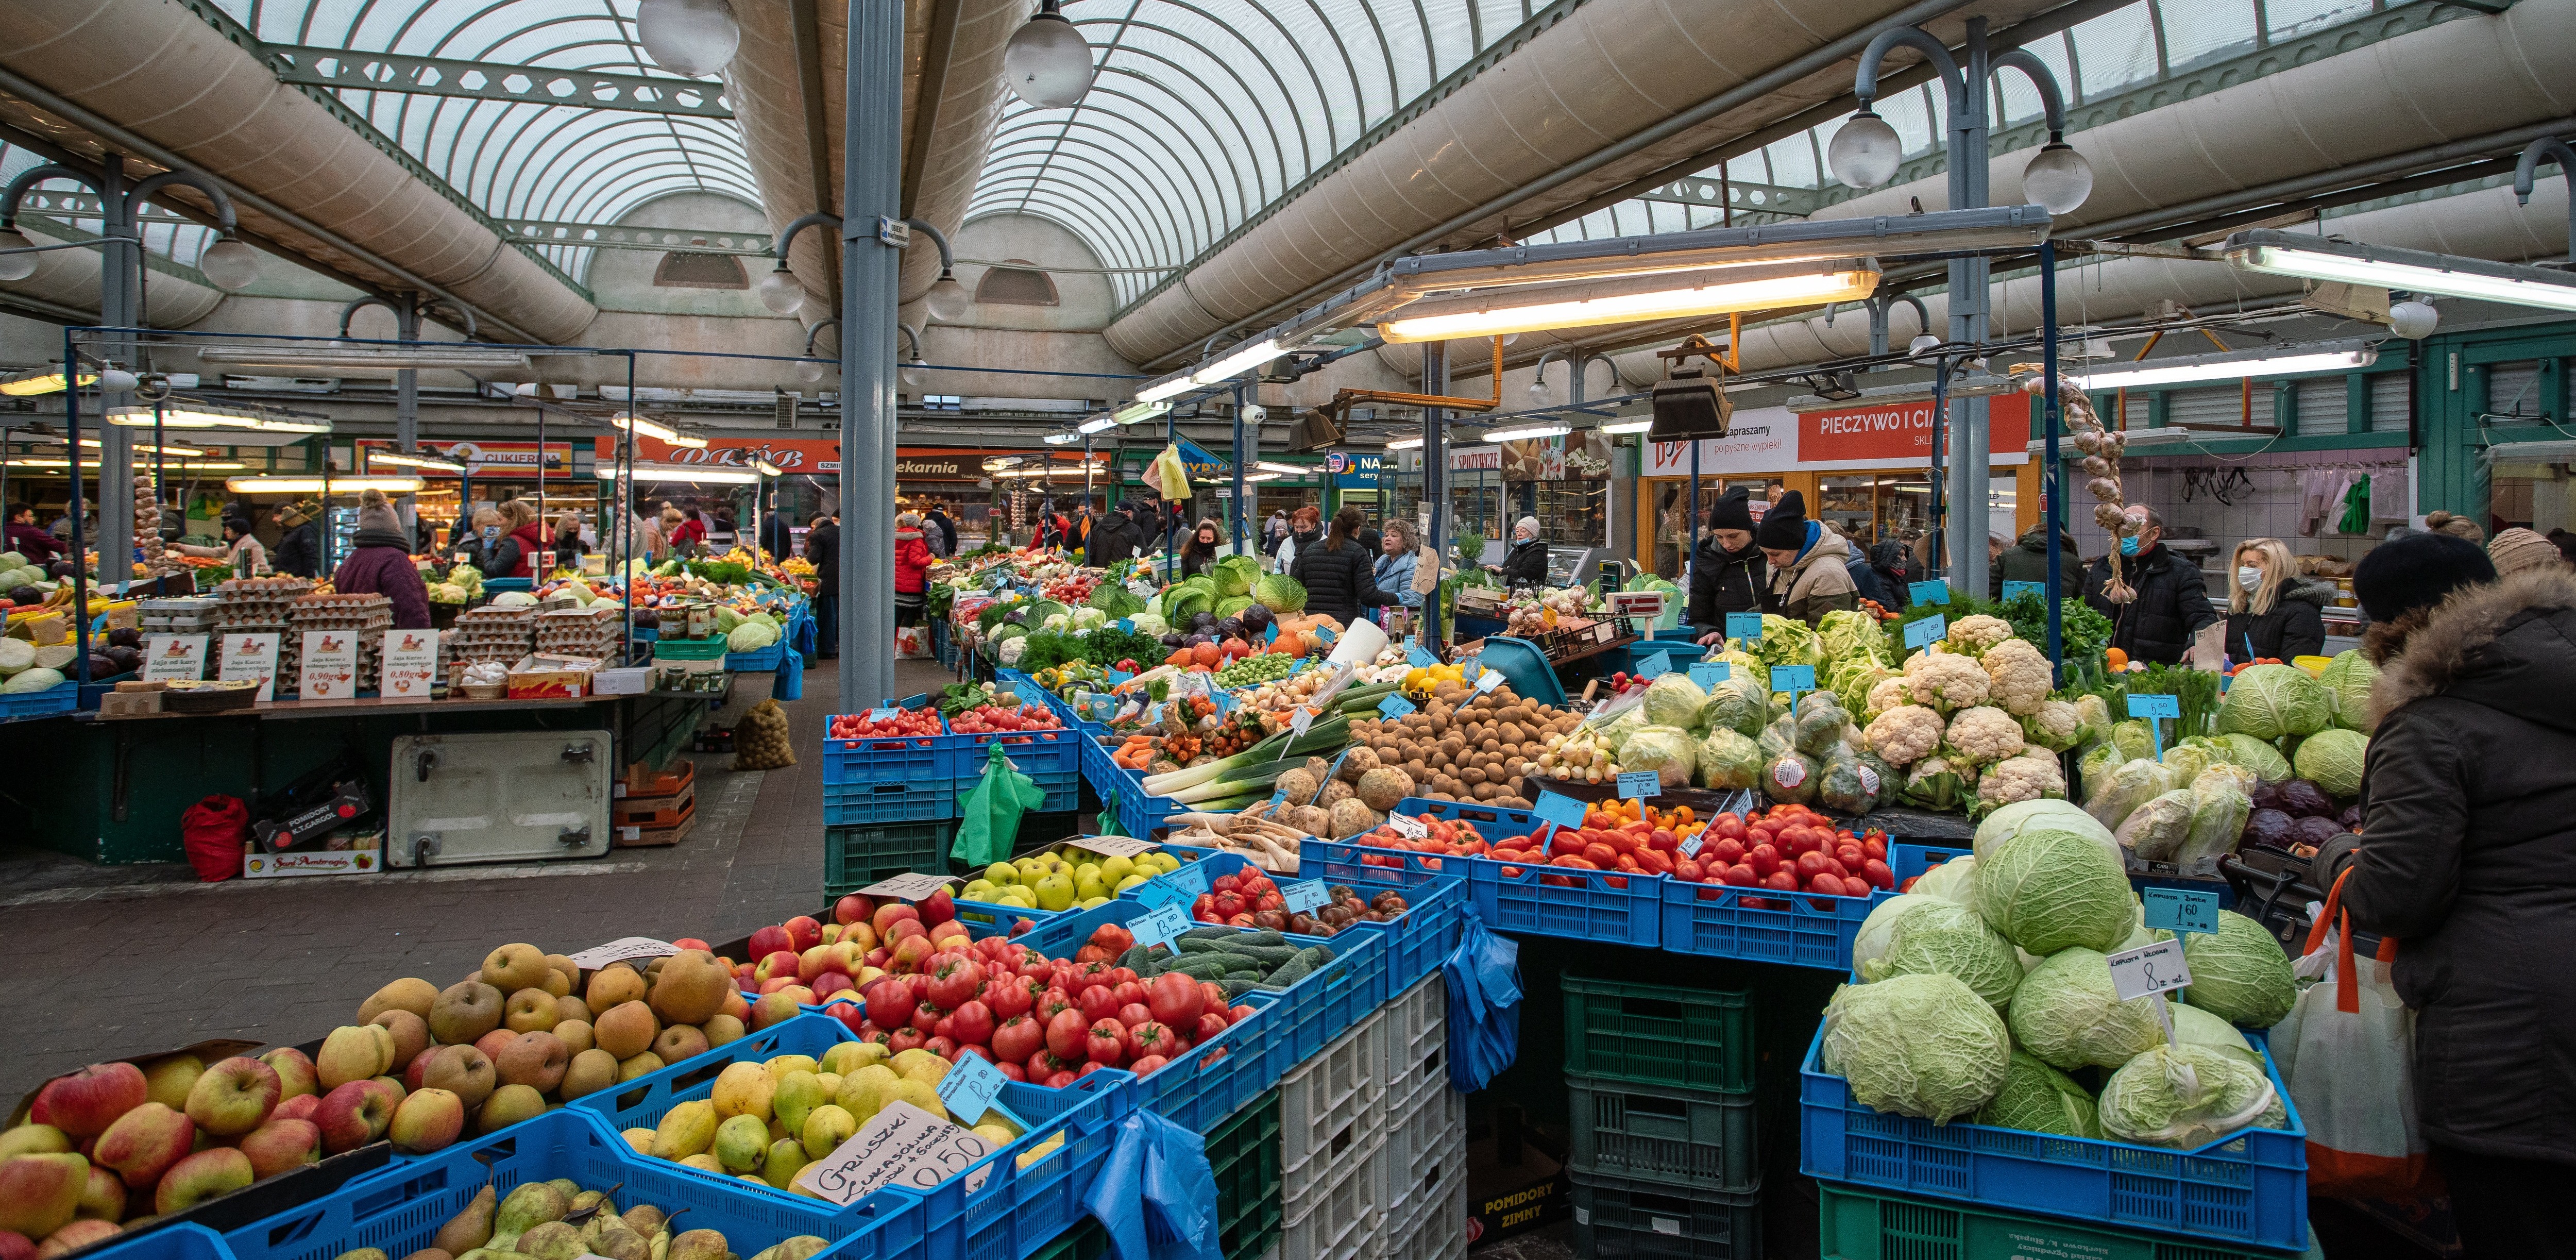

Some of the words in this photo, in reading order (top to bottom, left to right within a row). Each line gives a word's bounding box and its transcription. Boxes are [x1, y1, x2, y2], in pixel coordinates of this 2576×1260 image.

[1821, 412, 1900, 434] PIECZYWO
[1904, 411, 1908, 429] I
[1725, 426, 1770, 439] Zapraszamy
[1715, 445, 1723, 455] po
[1725, 443, 1750, 455] pyszne
[1752, 439, 1782, 453] wypieki!
[896, 461, 958, 473] ekarnia
[1459, 452, 1498, 469] SPOŻYWCZE
[1742, 622, 1747, 636] 4
[1923, 628, 1929, 641] 4
[1651, 664, 1657, 676] 3
[1706, 672, 1711, 686] 5
[1791, 675, 1795, 690] 5
[1024, 692, 1033, 702] 12
[2150, 703, 2156, 715] 5
[1296, 717, 1305, 730] 8
[1637, 783, 1645, 796] 16
[289, 804, 330, 827] POMIDORY
[1188, 878, 1196, 886] 80
[1304, 894, 1312, 909] 16
[2148, 892, 2178, 901] KAPUSTA
[2184, 895, 2206, 903] BIAŁA
[2176, 904, 2184, 926] 1
[2185, 904, 2197, 915] 60
[1156, 920, 1170, 938] 13
[1168, 914, 1177, 922] 80
[2110, 955, 2139, 967] KAPUSTA
[2143, 948, 2168, 959] WŁOSKA
[2144, 962, 2158, 990] 8
[939, 1081, 953, 1098] OMIDOR
[953, 1056, 972, 1078] MALINOWY
[977, 1069, 988, 1080] 80
[969, 1081, 992, 1104] 12
[818, 1113, 910, 1191] GRUSZKI
[842, 1125, 938, 1203] ŁUKASÓWKA
[1485, 1183, 1554, 1215] POMIDORY
[1502, 1205, 1542, 1228] ZIMNY
[2017, 1243, 2068, 1258] Ogrodniczy
[2062, 1242, 2108, 1255] Bierkowo
